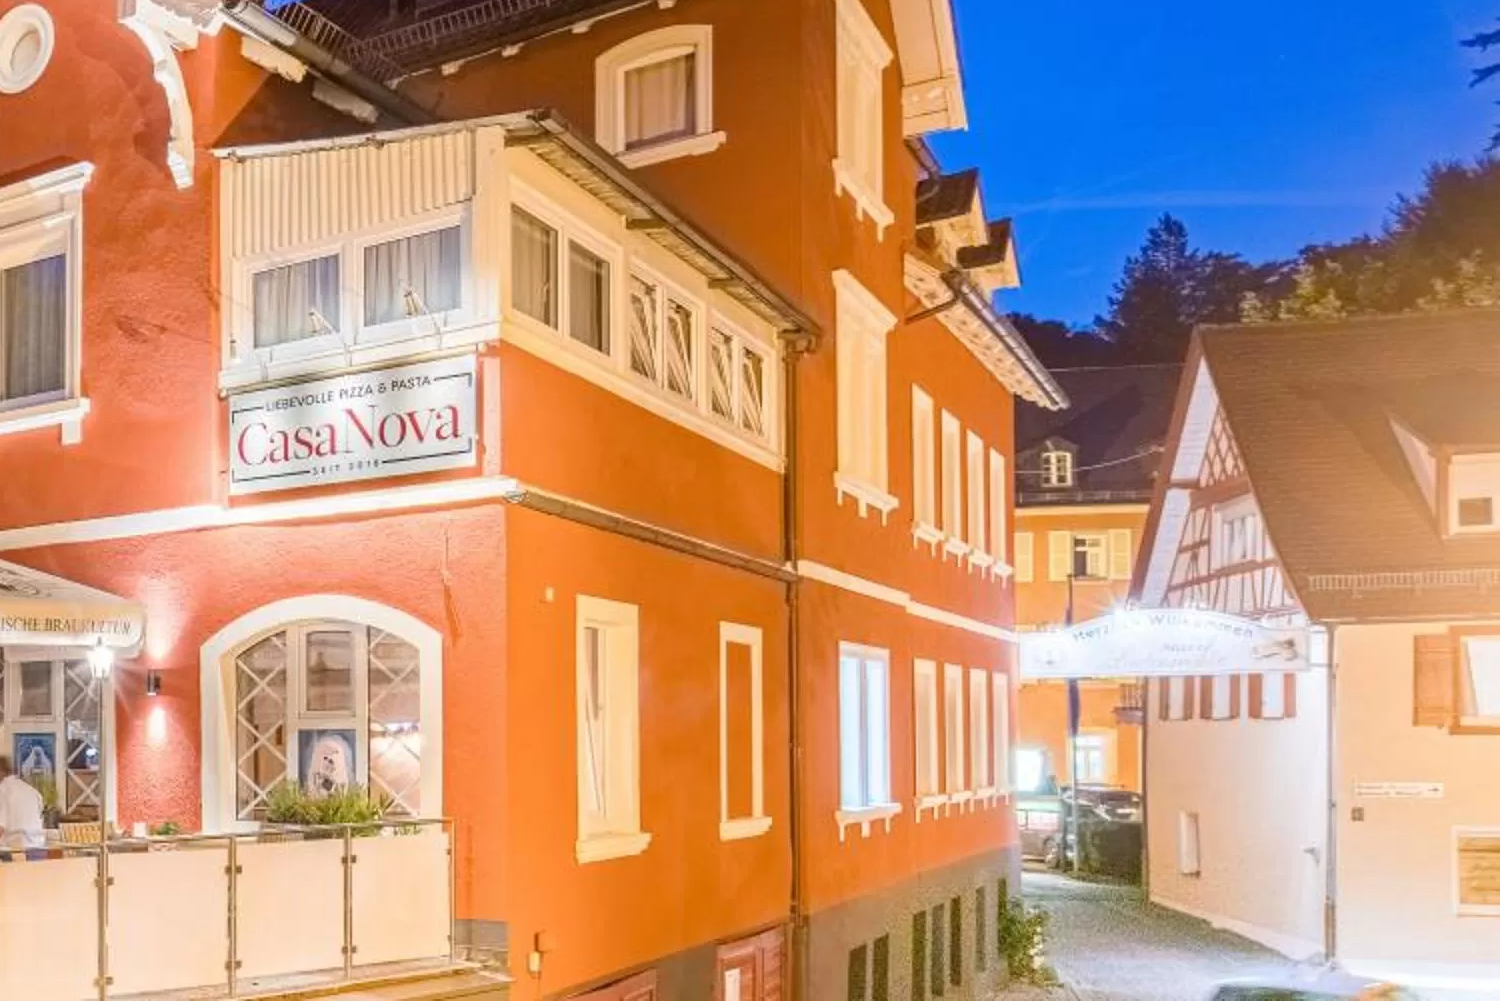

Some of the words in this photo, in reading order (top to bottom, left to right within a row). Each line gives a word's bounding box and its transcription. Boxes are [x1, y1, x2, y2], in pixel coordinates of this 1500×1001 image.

[265, 390, 334, 412] LIEBEVOLLE
[339, 384, 373, 400] PIZZA
[377, 382, 387, 394] &
[391, 376, 431, 392] PASTA
